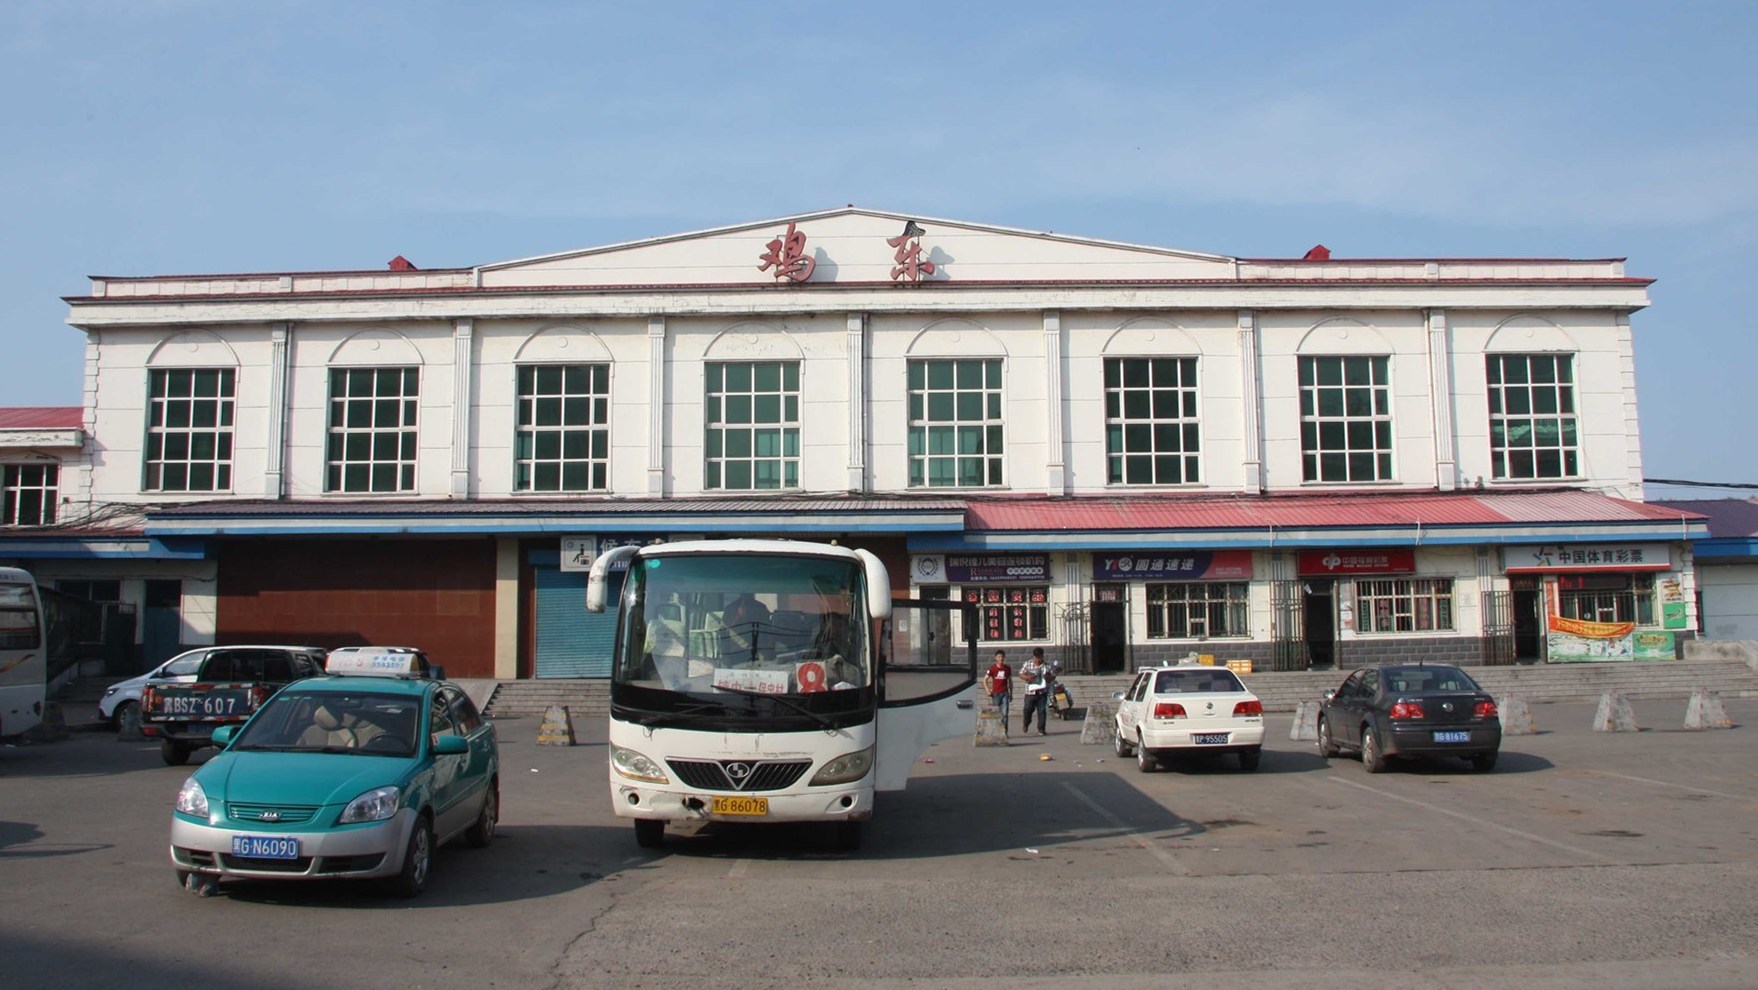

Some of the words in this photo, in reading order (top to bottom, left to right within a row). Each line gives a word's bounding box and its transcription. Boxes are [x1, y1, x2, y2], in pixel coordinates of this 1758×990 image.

[758, 221, 934, 282] 鸡东
[601, 538, 665, 553] 候车
[1558, 549, 1643, 564] 中国体育彩票
[714, 799, 766, 813] 黑G·86078
